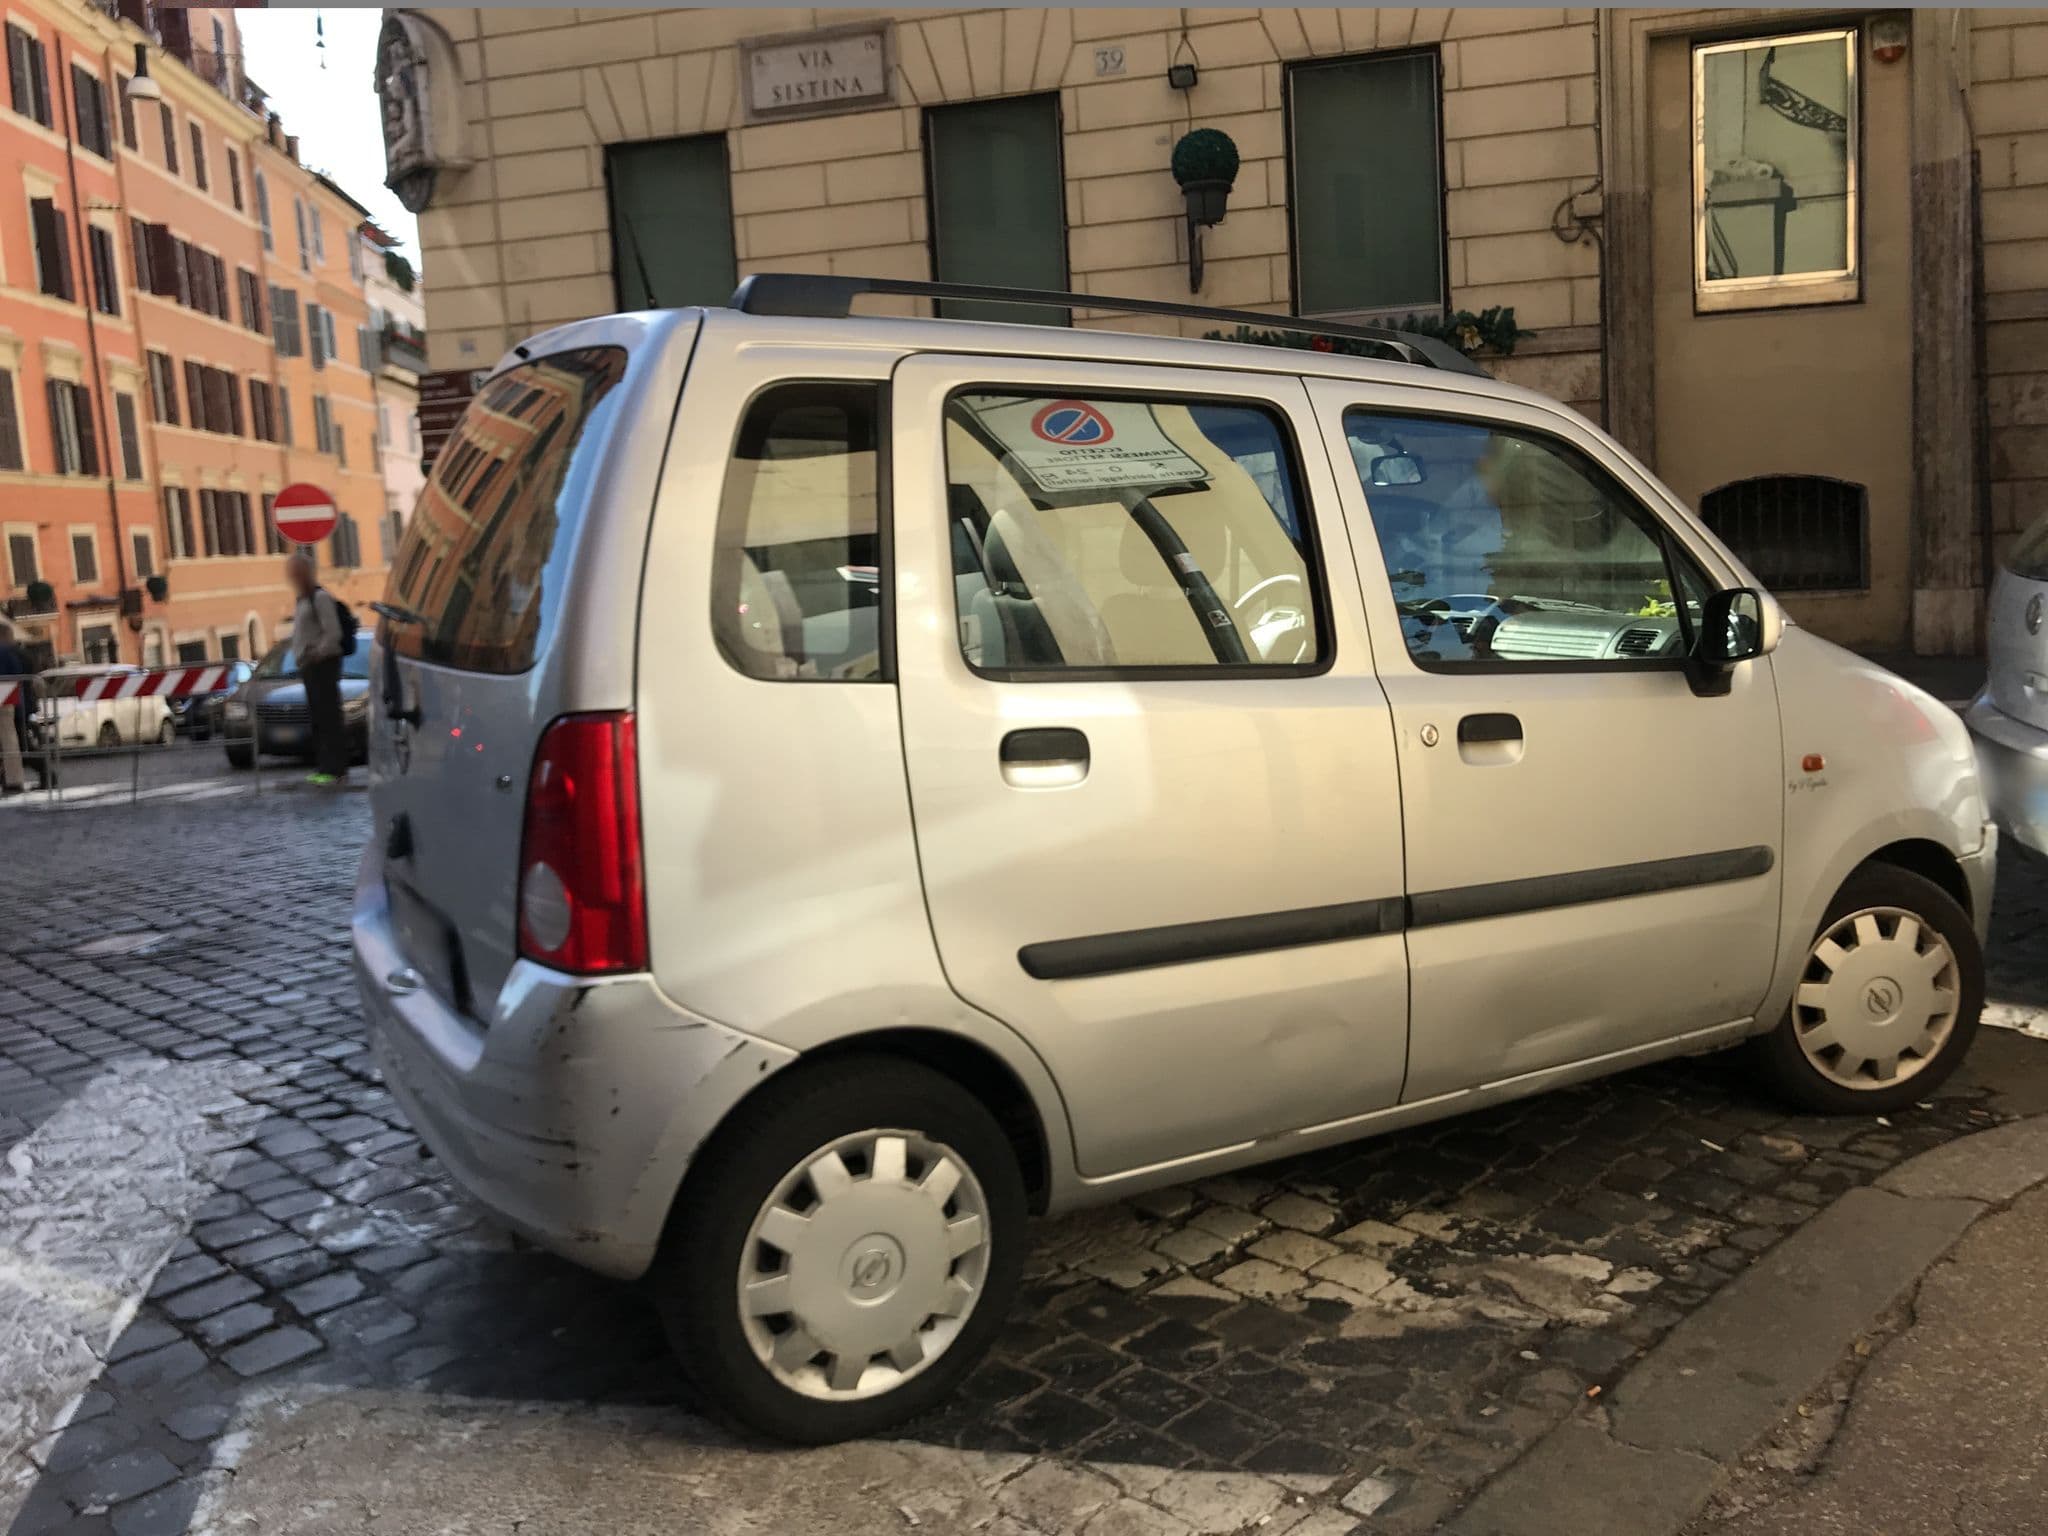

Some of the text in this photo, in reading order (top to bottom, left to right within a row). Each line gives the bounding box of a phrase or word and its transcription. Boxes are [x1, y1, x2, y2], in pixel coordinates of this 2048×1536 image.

[798, 49, 833, 68] VIA
[1096, 48, 1123, 73] 39
[771, 76, 863, 103] SISTINA
